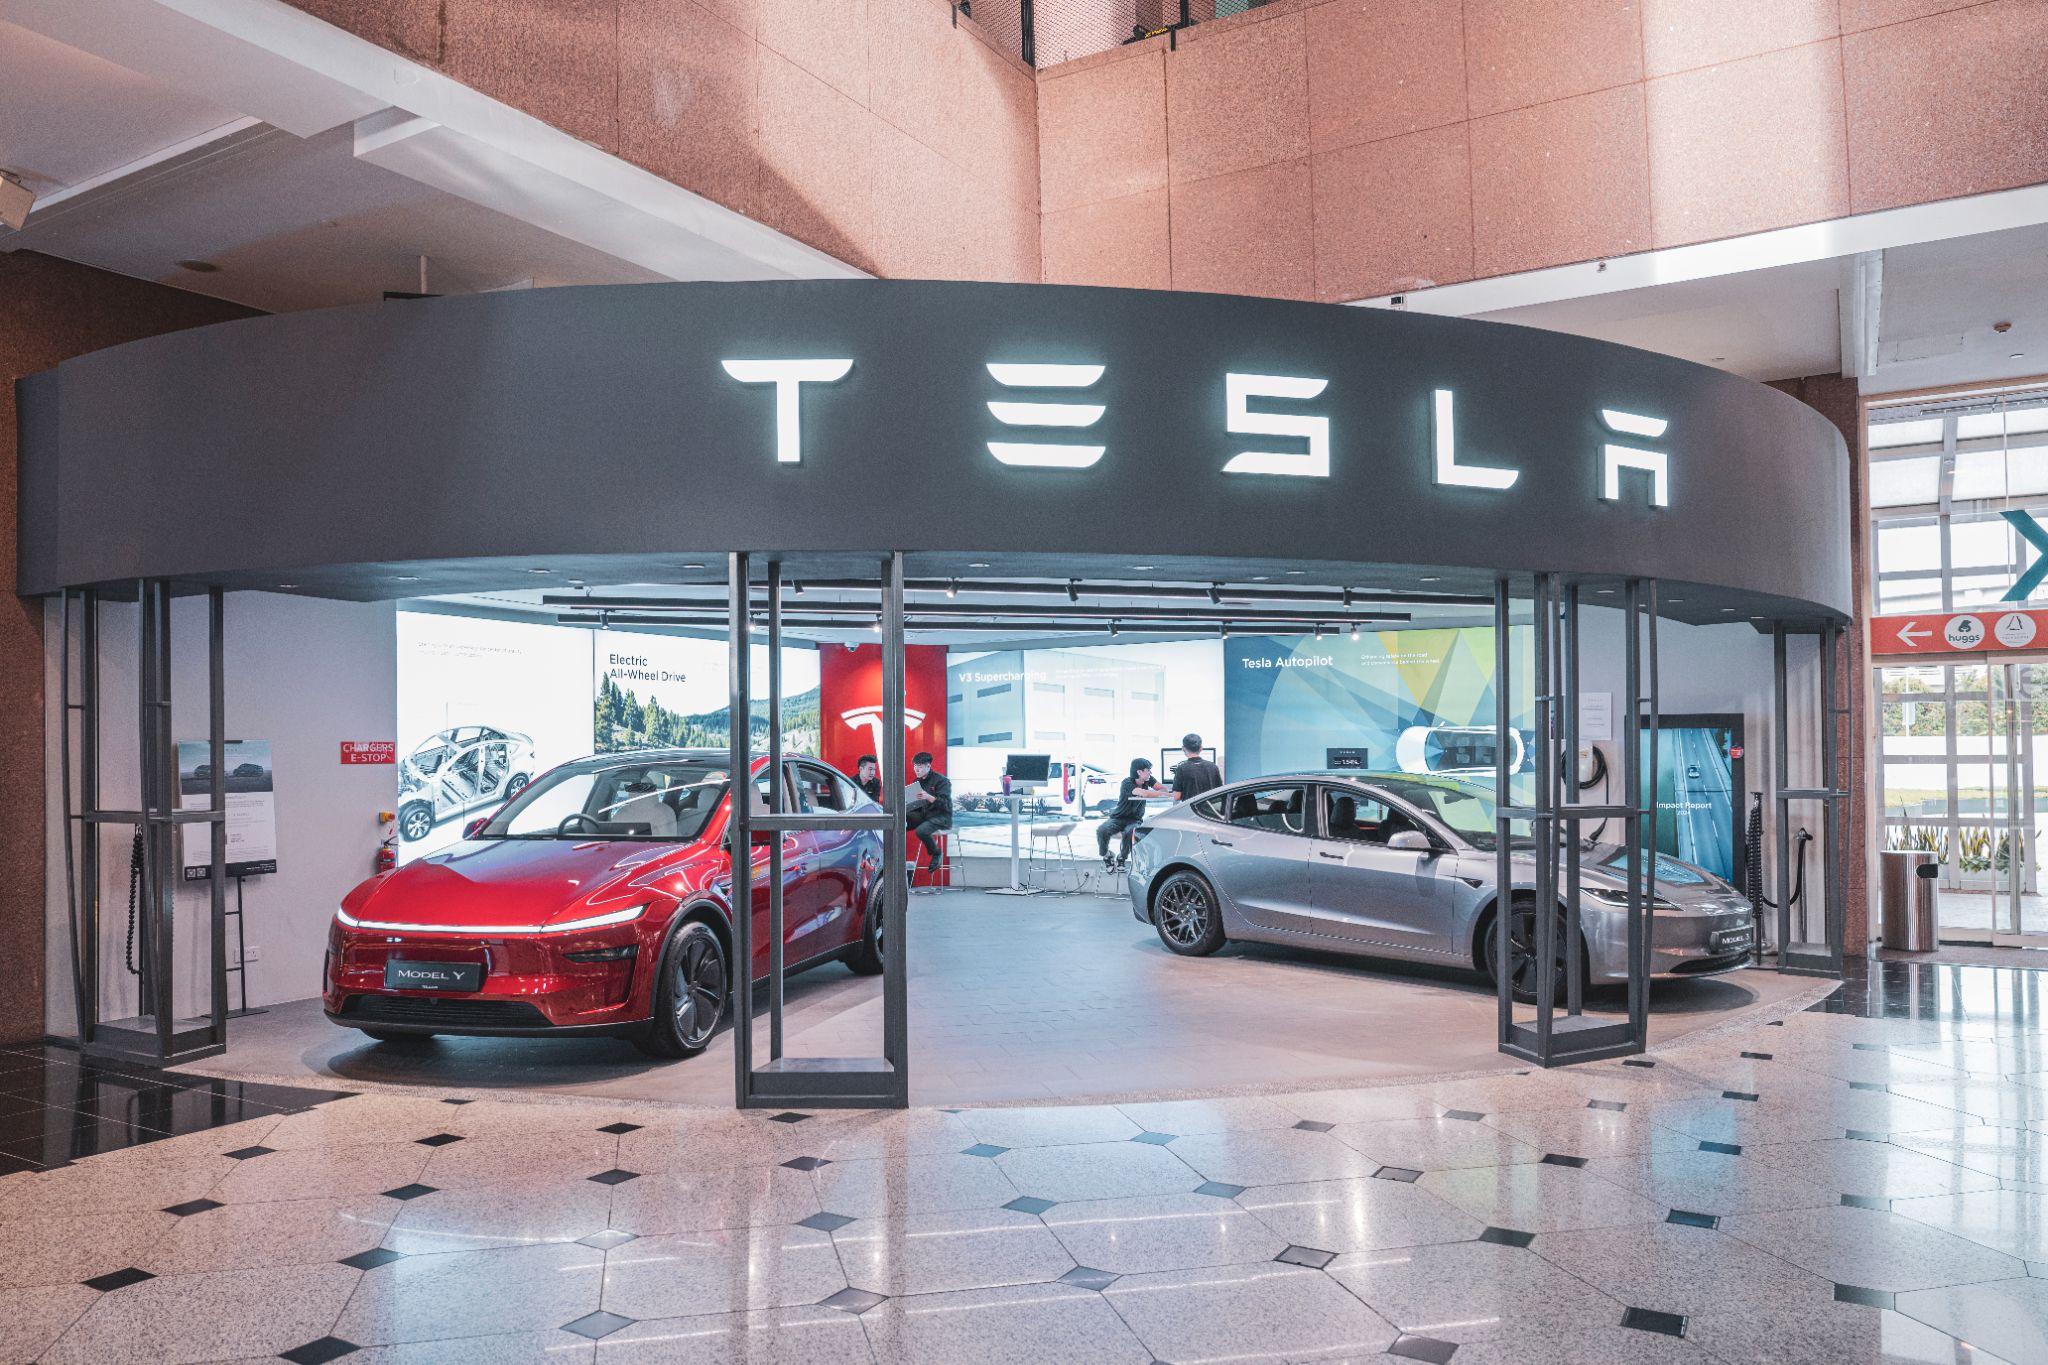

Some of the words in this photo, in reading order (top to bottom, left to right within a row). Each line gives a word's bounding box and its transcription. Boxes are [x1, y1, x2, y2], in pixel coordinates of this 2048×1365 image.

[721, 358, 1668, 508] TESLA
[1948, 633, 1981, 644] huggs
[609, 653, 648, 667] Electric
[1241, 657, 1272, 669] Tesla
[1275, 655, 1334, 669] Autopilot
[609, 668, 659, 681] All-Wheel
[661, 670, 687, 683] Drive
[958, 672, 972, 683] V3
[974, 671, 1047, 684] Supercharging
[342, 743, 394, 753] CHARGERS
[350, 753, 387, 762] E-STOP
[1656, 801, 1683, 811] Impact
[1685, 801, 1713, 811] Report
[398, 969, 450, 980] MODEL
[452, 971, 466, 981] Y
